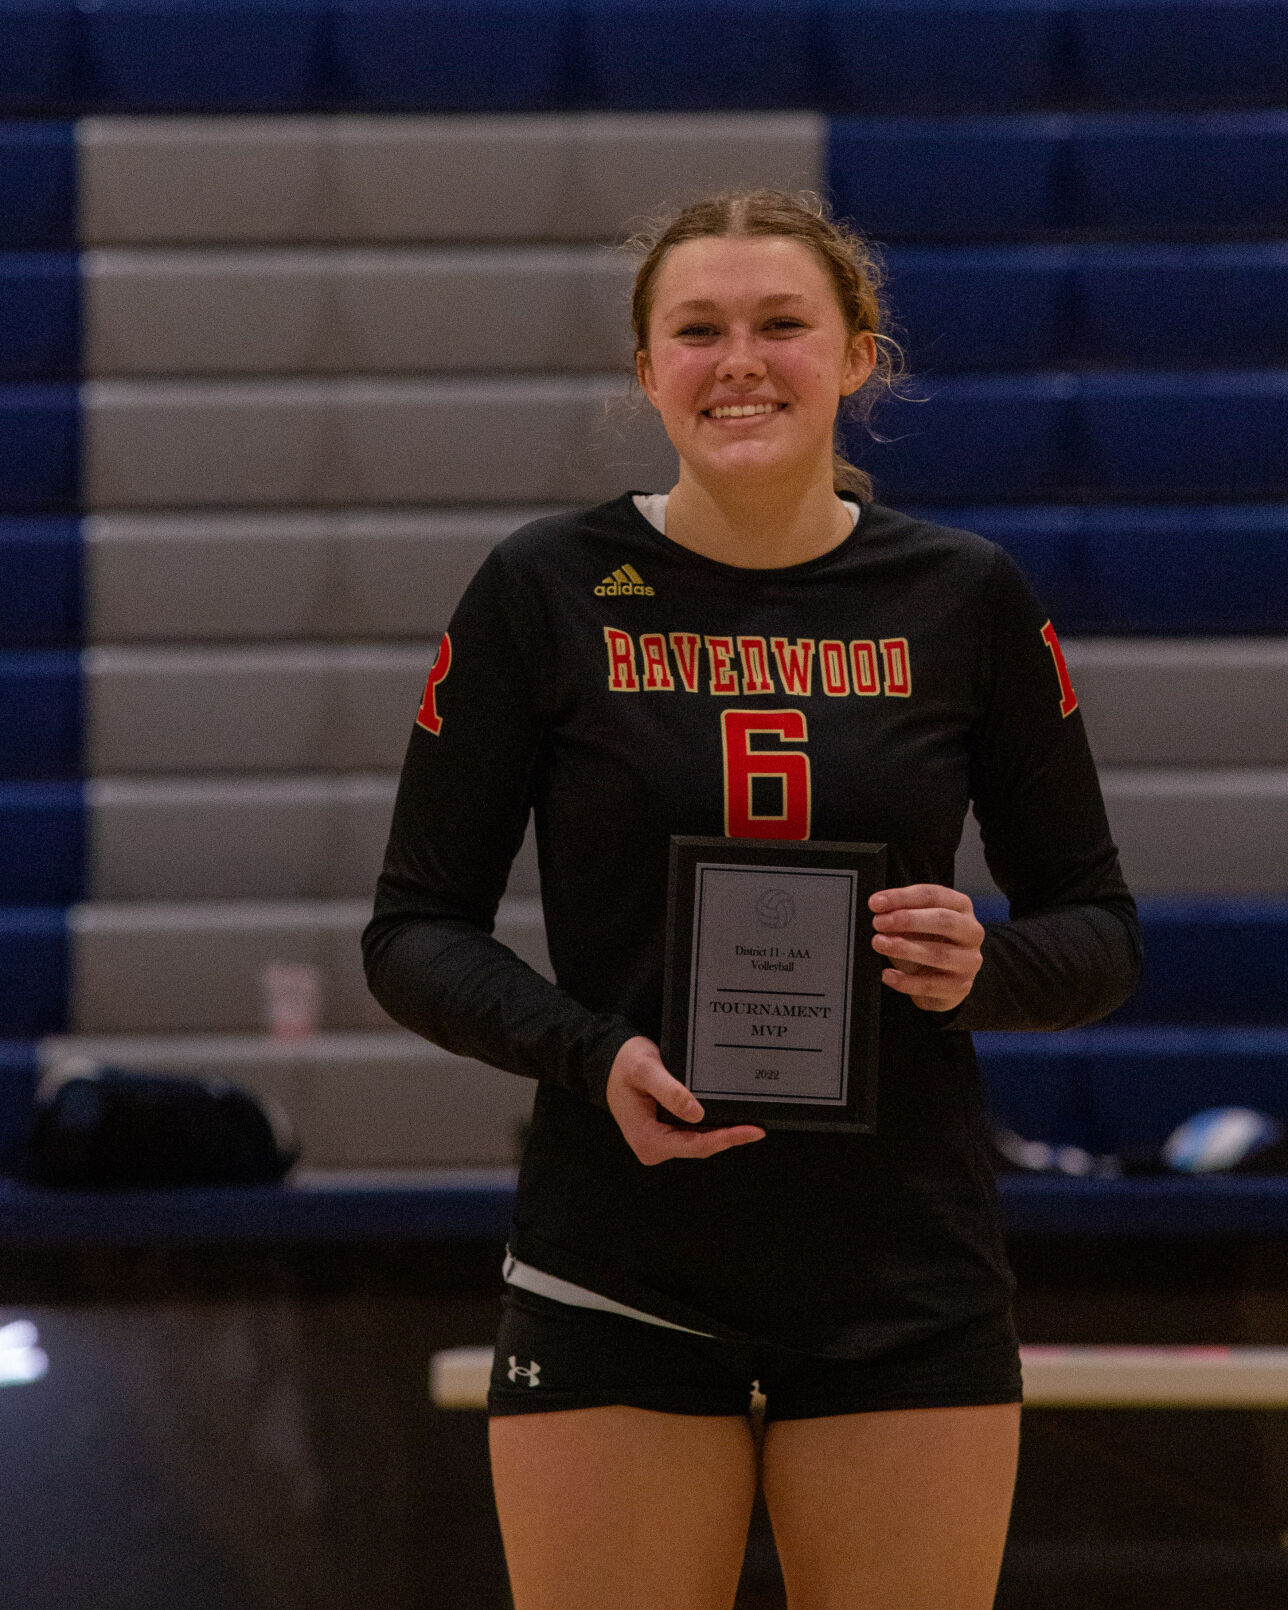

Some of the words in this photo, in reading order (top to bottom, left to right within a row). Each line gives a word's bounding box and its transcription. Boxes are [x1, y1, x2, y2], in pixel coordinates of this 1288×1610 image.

[593, 580, 656, 597] adidas
[603, 626, 912, 698] RAVENWOOD
[720, 708, 812, 841] 6
[735, 945, 767, 957] District
[770, 947, 779, 957] 11
[787, 948, 811, 959] AAA
[751, 960, 795, 972] Volleyball
[709, 1001, 832, 1018] TOURNAMENT
[751, 1024, 788, 1037] MVP
[754, 1069, 780, 1080] 2022
